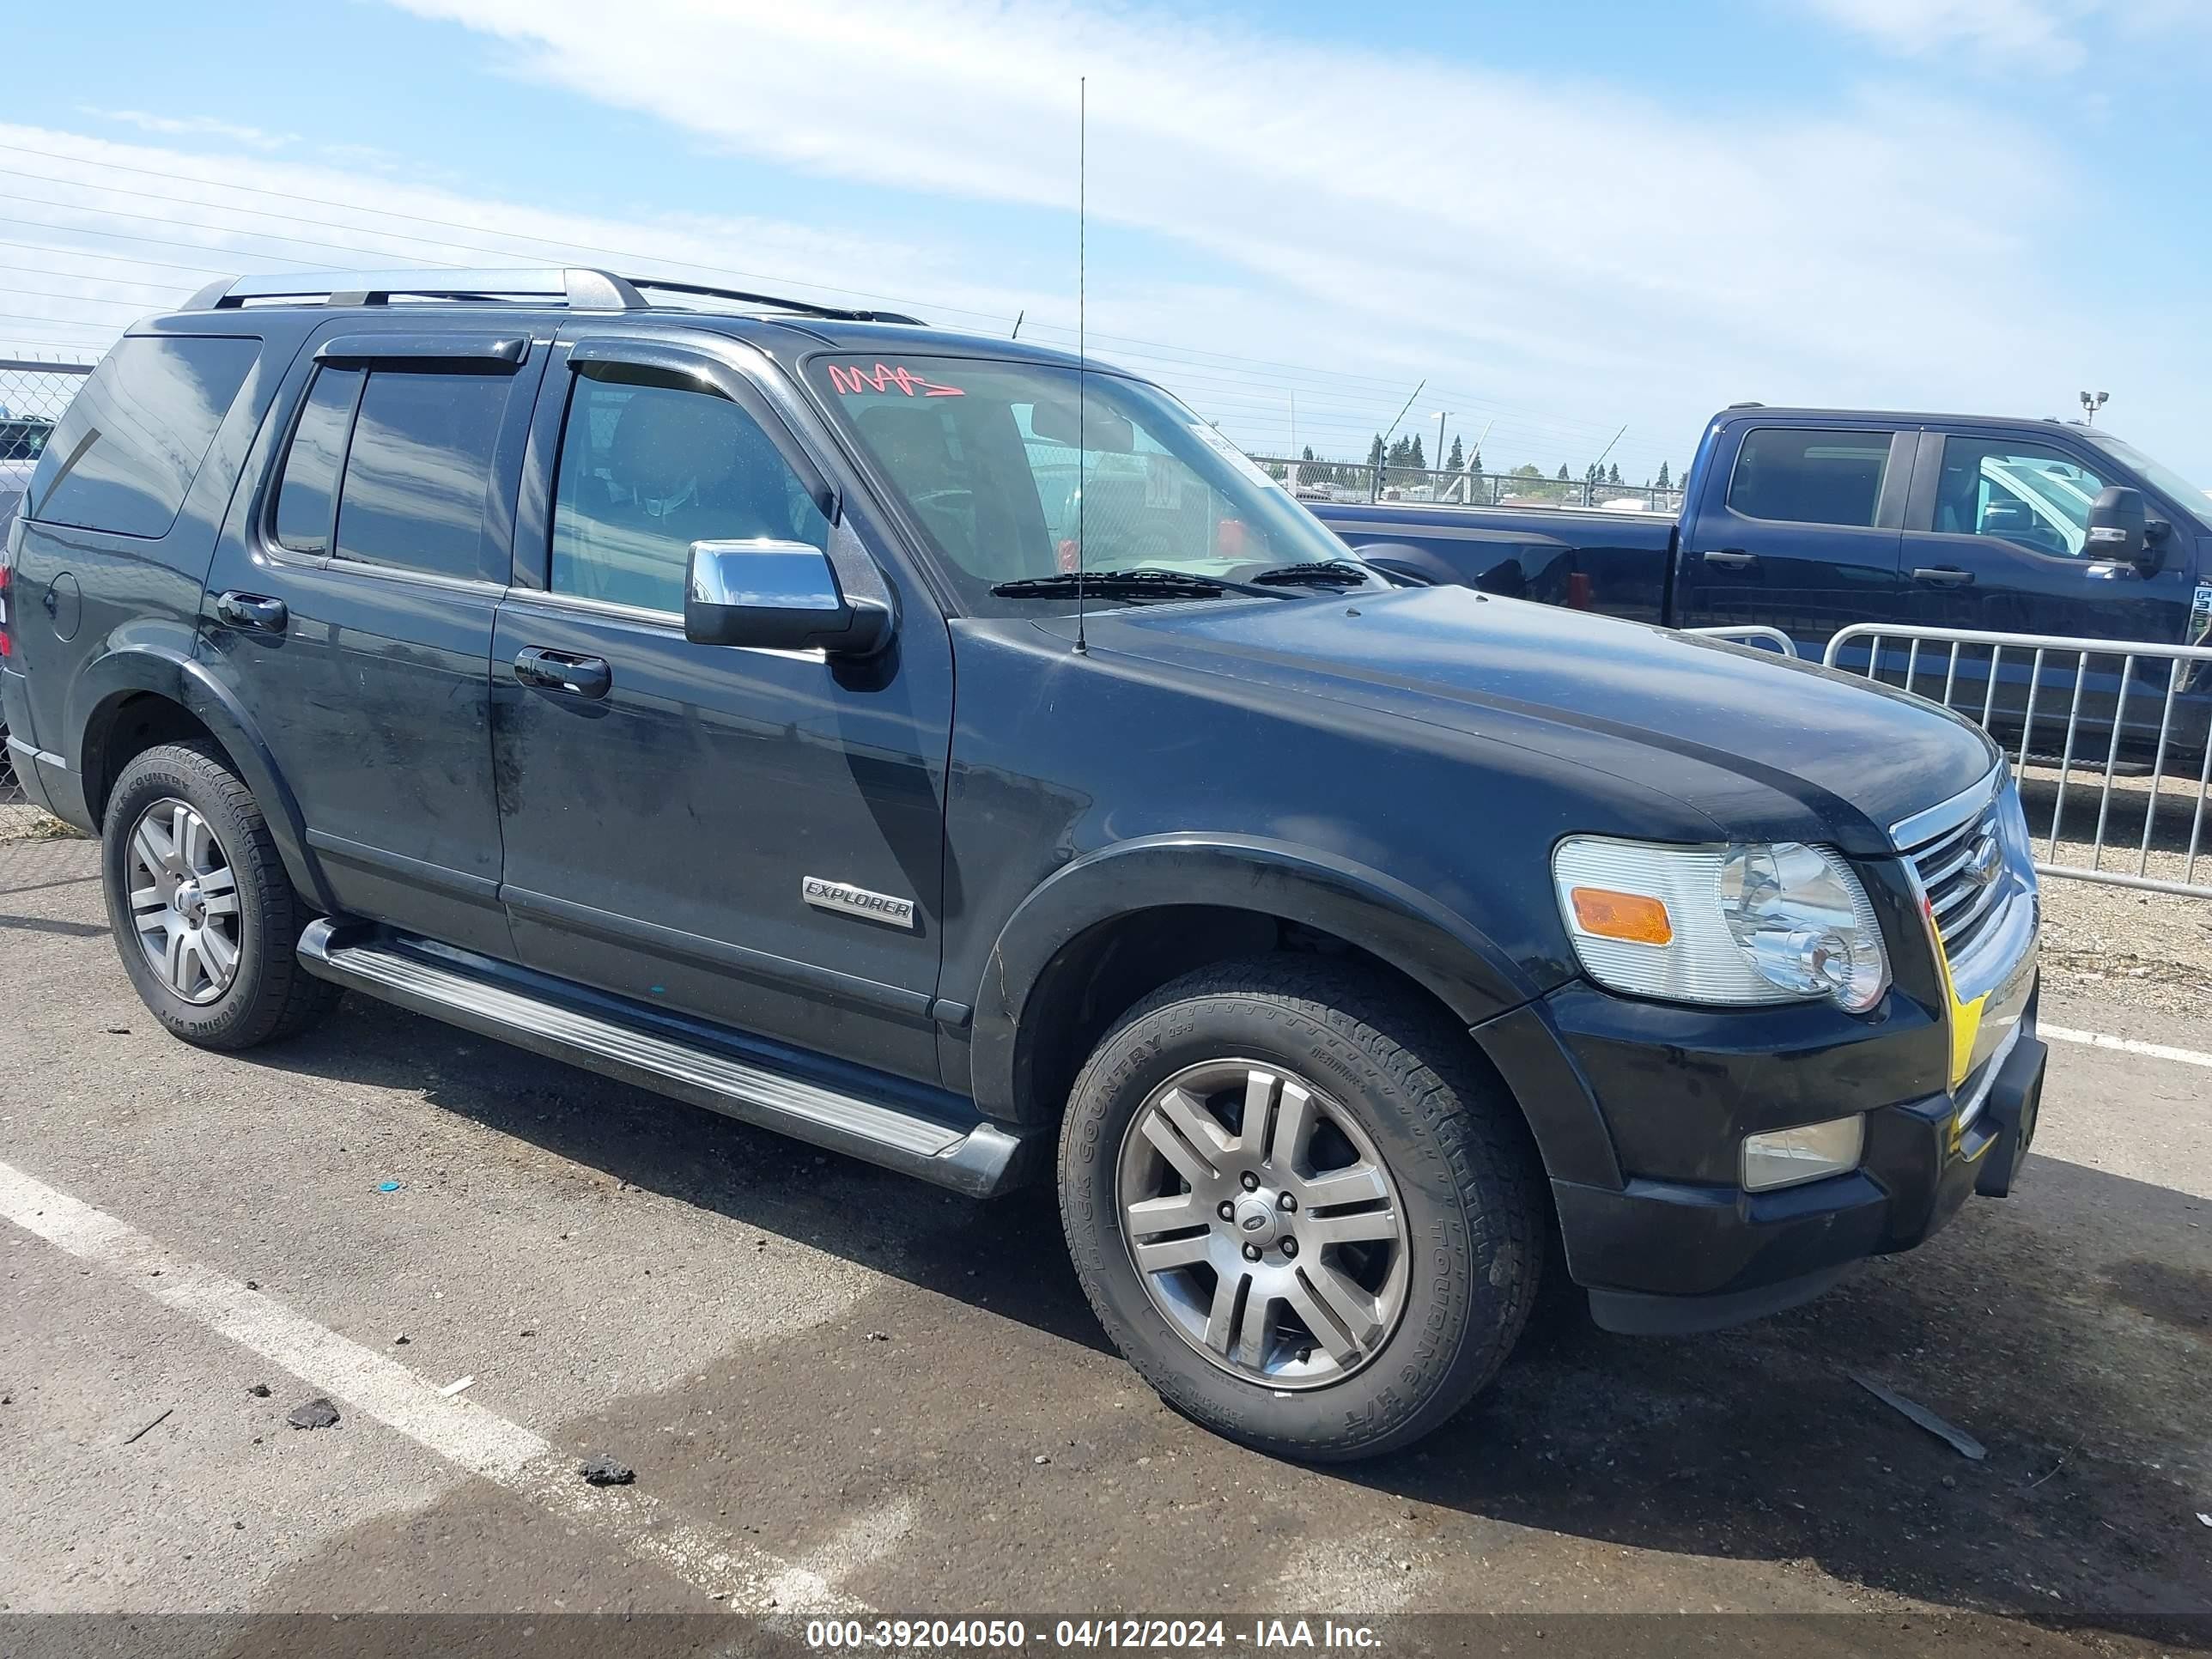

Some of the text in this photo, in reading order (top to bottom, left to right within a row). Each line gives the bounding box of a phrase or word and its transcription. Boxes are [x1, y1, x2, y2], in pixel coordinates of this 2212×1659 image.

[128, 772, 190, 791] COUNTRY
[805, 880, 912, 918] EXPLORER
[190, 993, 246, 1031] TOURING
[1079, 1033, 1164, 1164] COUNTRY
[1078, 1174, 1106, 1272] BACK
[1344, 1218, 1451, 1429] TOURING H/T
